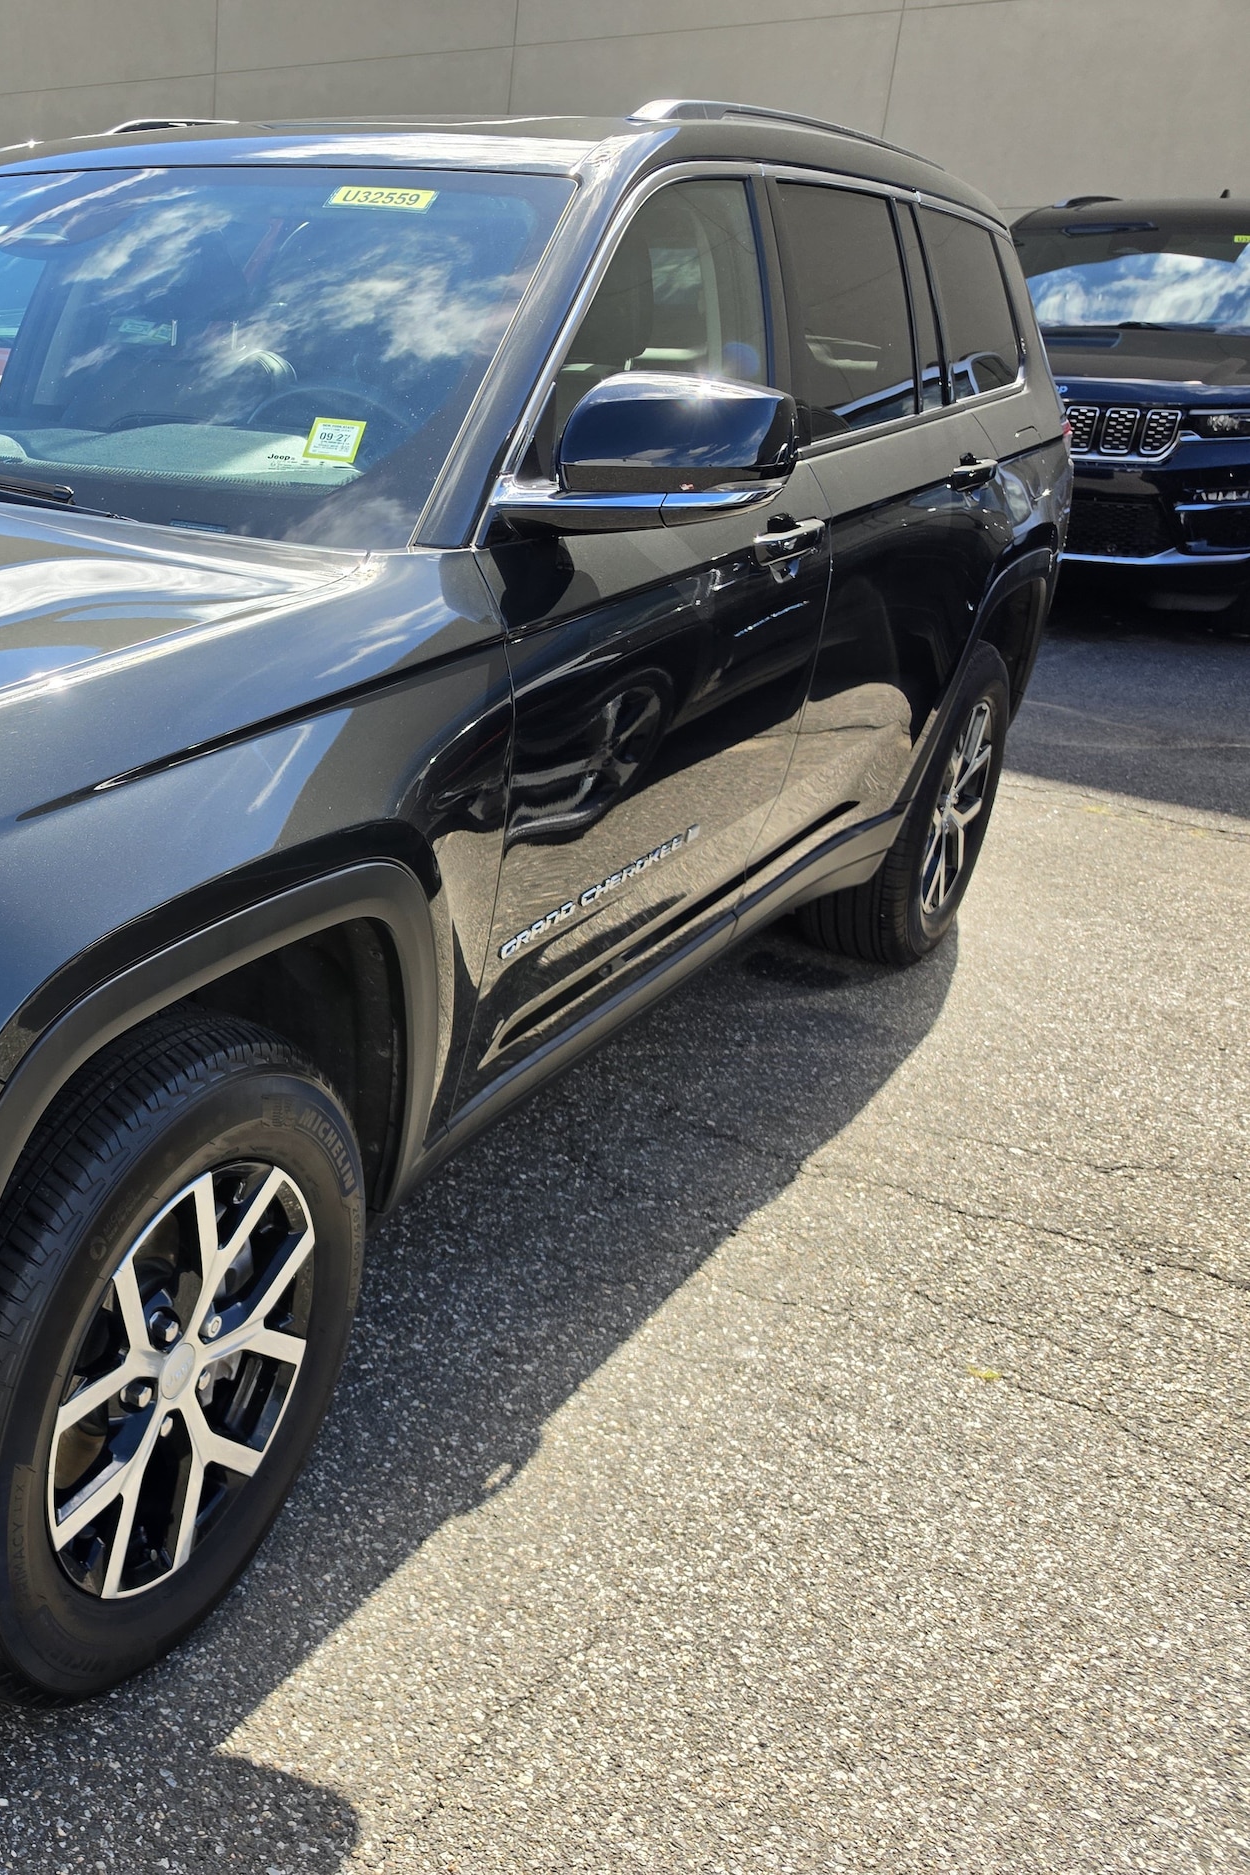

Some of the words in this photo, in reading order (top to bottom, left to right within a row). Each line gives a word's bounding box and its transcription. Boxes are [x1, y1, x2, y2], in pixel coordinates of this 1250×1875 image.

[342, 189, 421, 206] U32559
[267, 453, 291, 461] Jeep
[498, 900, 577, 961] GRAND
[578, 833, 684, 908] CHEROKEE
[298, 1107, 356, 1191] MICHELIN
